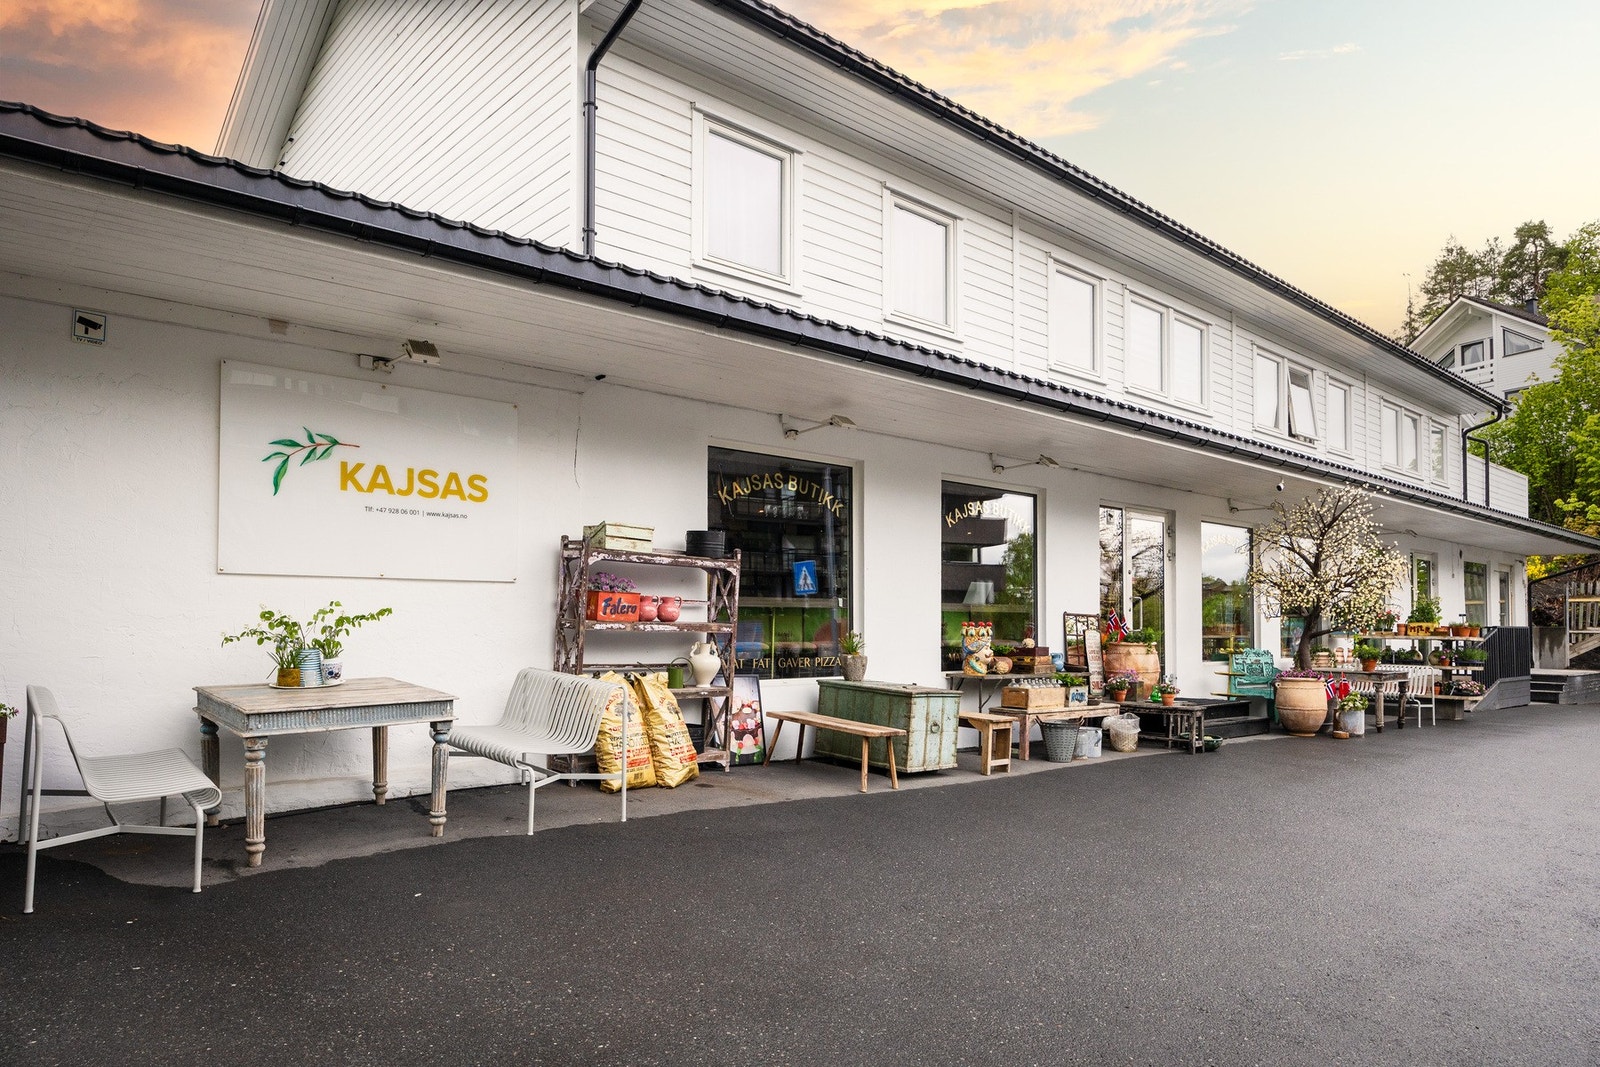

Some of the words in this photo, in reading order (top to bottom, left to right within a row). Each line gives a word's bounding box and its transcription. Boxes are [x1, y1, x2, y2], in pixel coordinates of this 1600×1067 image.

[339, 461, 489, 503] KAJSAS
[718, 473, 784, 506] KAJSAS
[787, 475, 844, 518] BUTIKK
[400, 508, 409, 516] 06
[426, 511, 468, 520] www.kajsas.no
[945, 500, 990, 528] KAJSAS
[601, 596, 638, 616] Falero
[753, 658, 770, 669] FAT
[778, 658, 811, 669] GAVER
[815, 656, 842, 667] PIZZA
